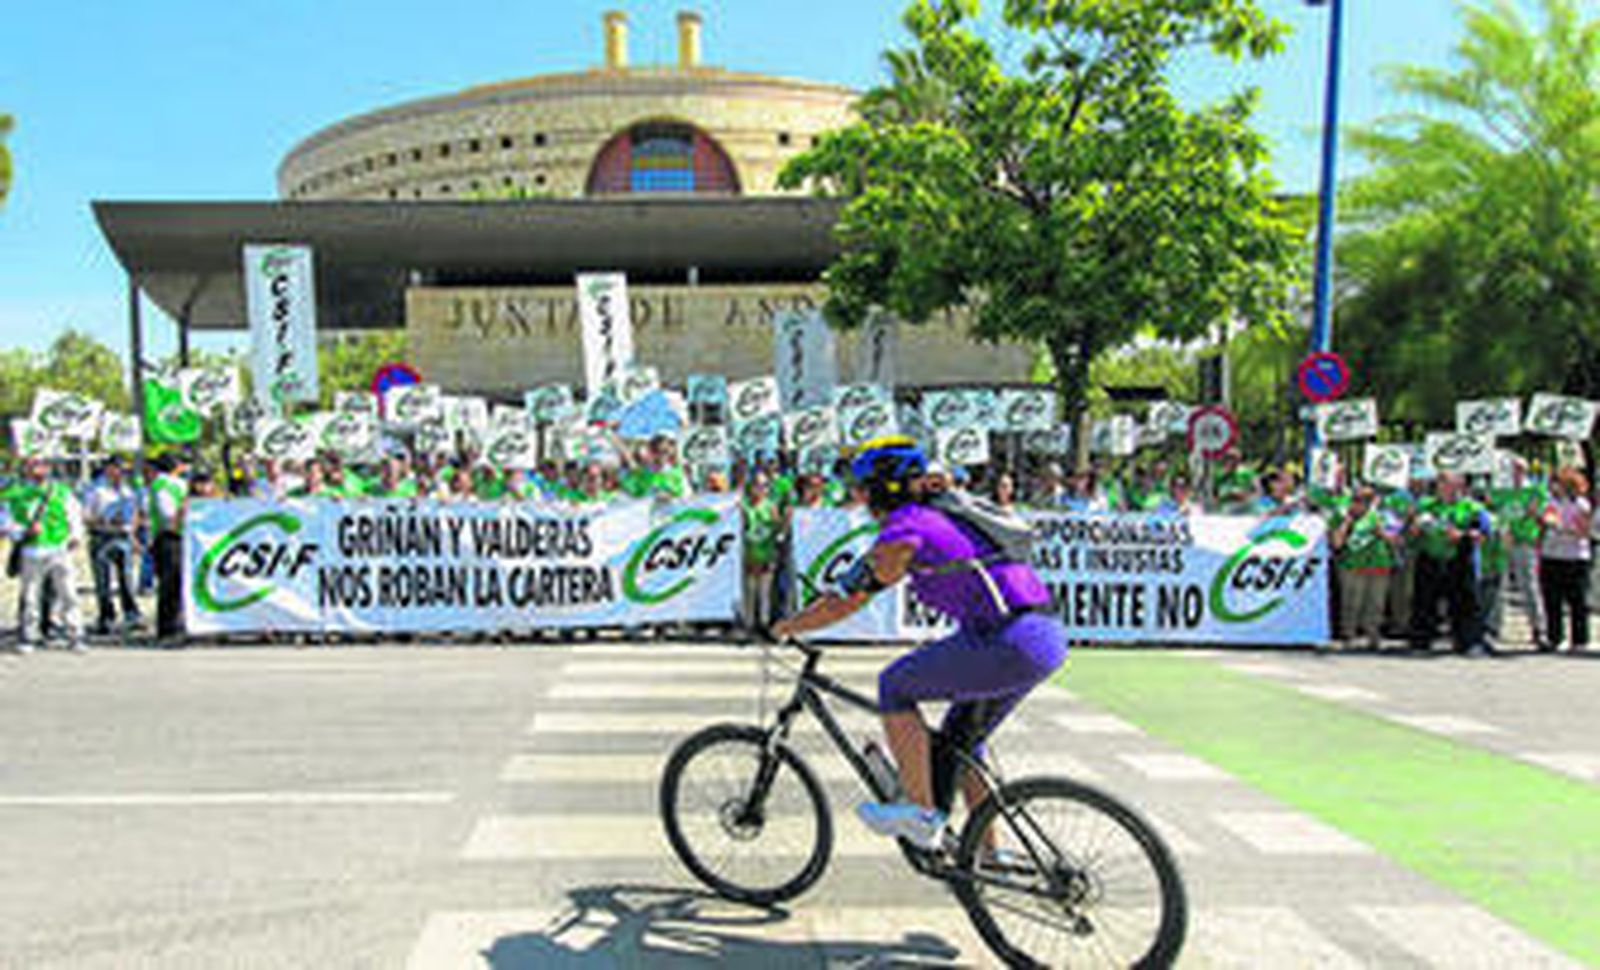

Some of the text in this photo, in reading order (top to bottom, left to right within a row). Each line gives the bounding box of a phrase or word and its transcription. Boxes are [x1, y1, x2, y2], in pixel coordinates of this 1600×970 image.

[337, 504, 594, 559] GRIÑÁN Y VALDERAS
[1031, 518, 1191, 547] OPORCIONADAS
[1069, 546, 1079, 571] E
[1085, 547, 1185, 575] INJUSTAS
[317, 564, 616, 608] NOS ROBAN LA CARTERA
[1045, 581, 1146, 628] MENTE
[1156, 581, 1205, 630] NO
